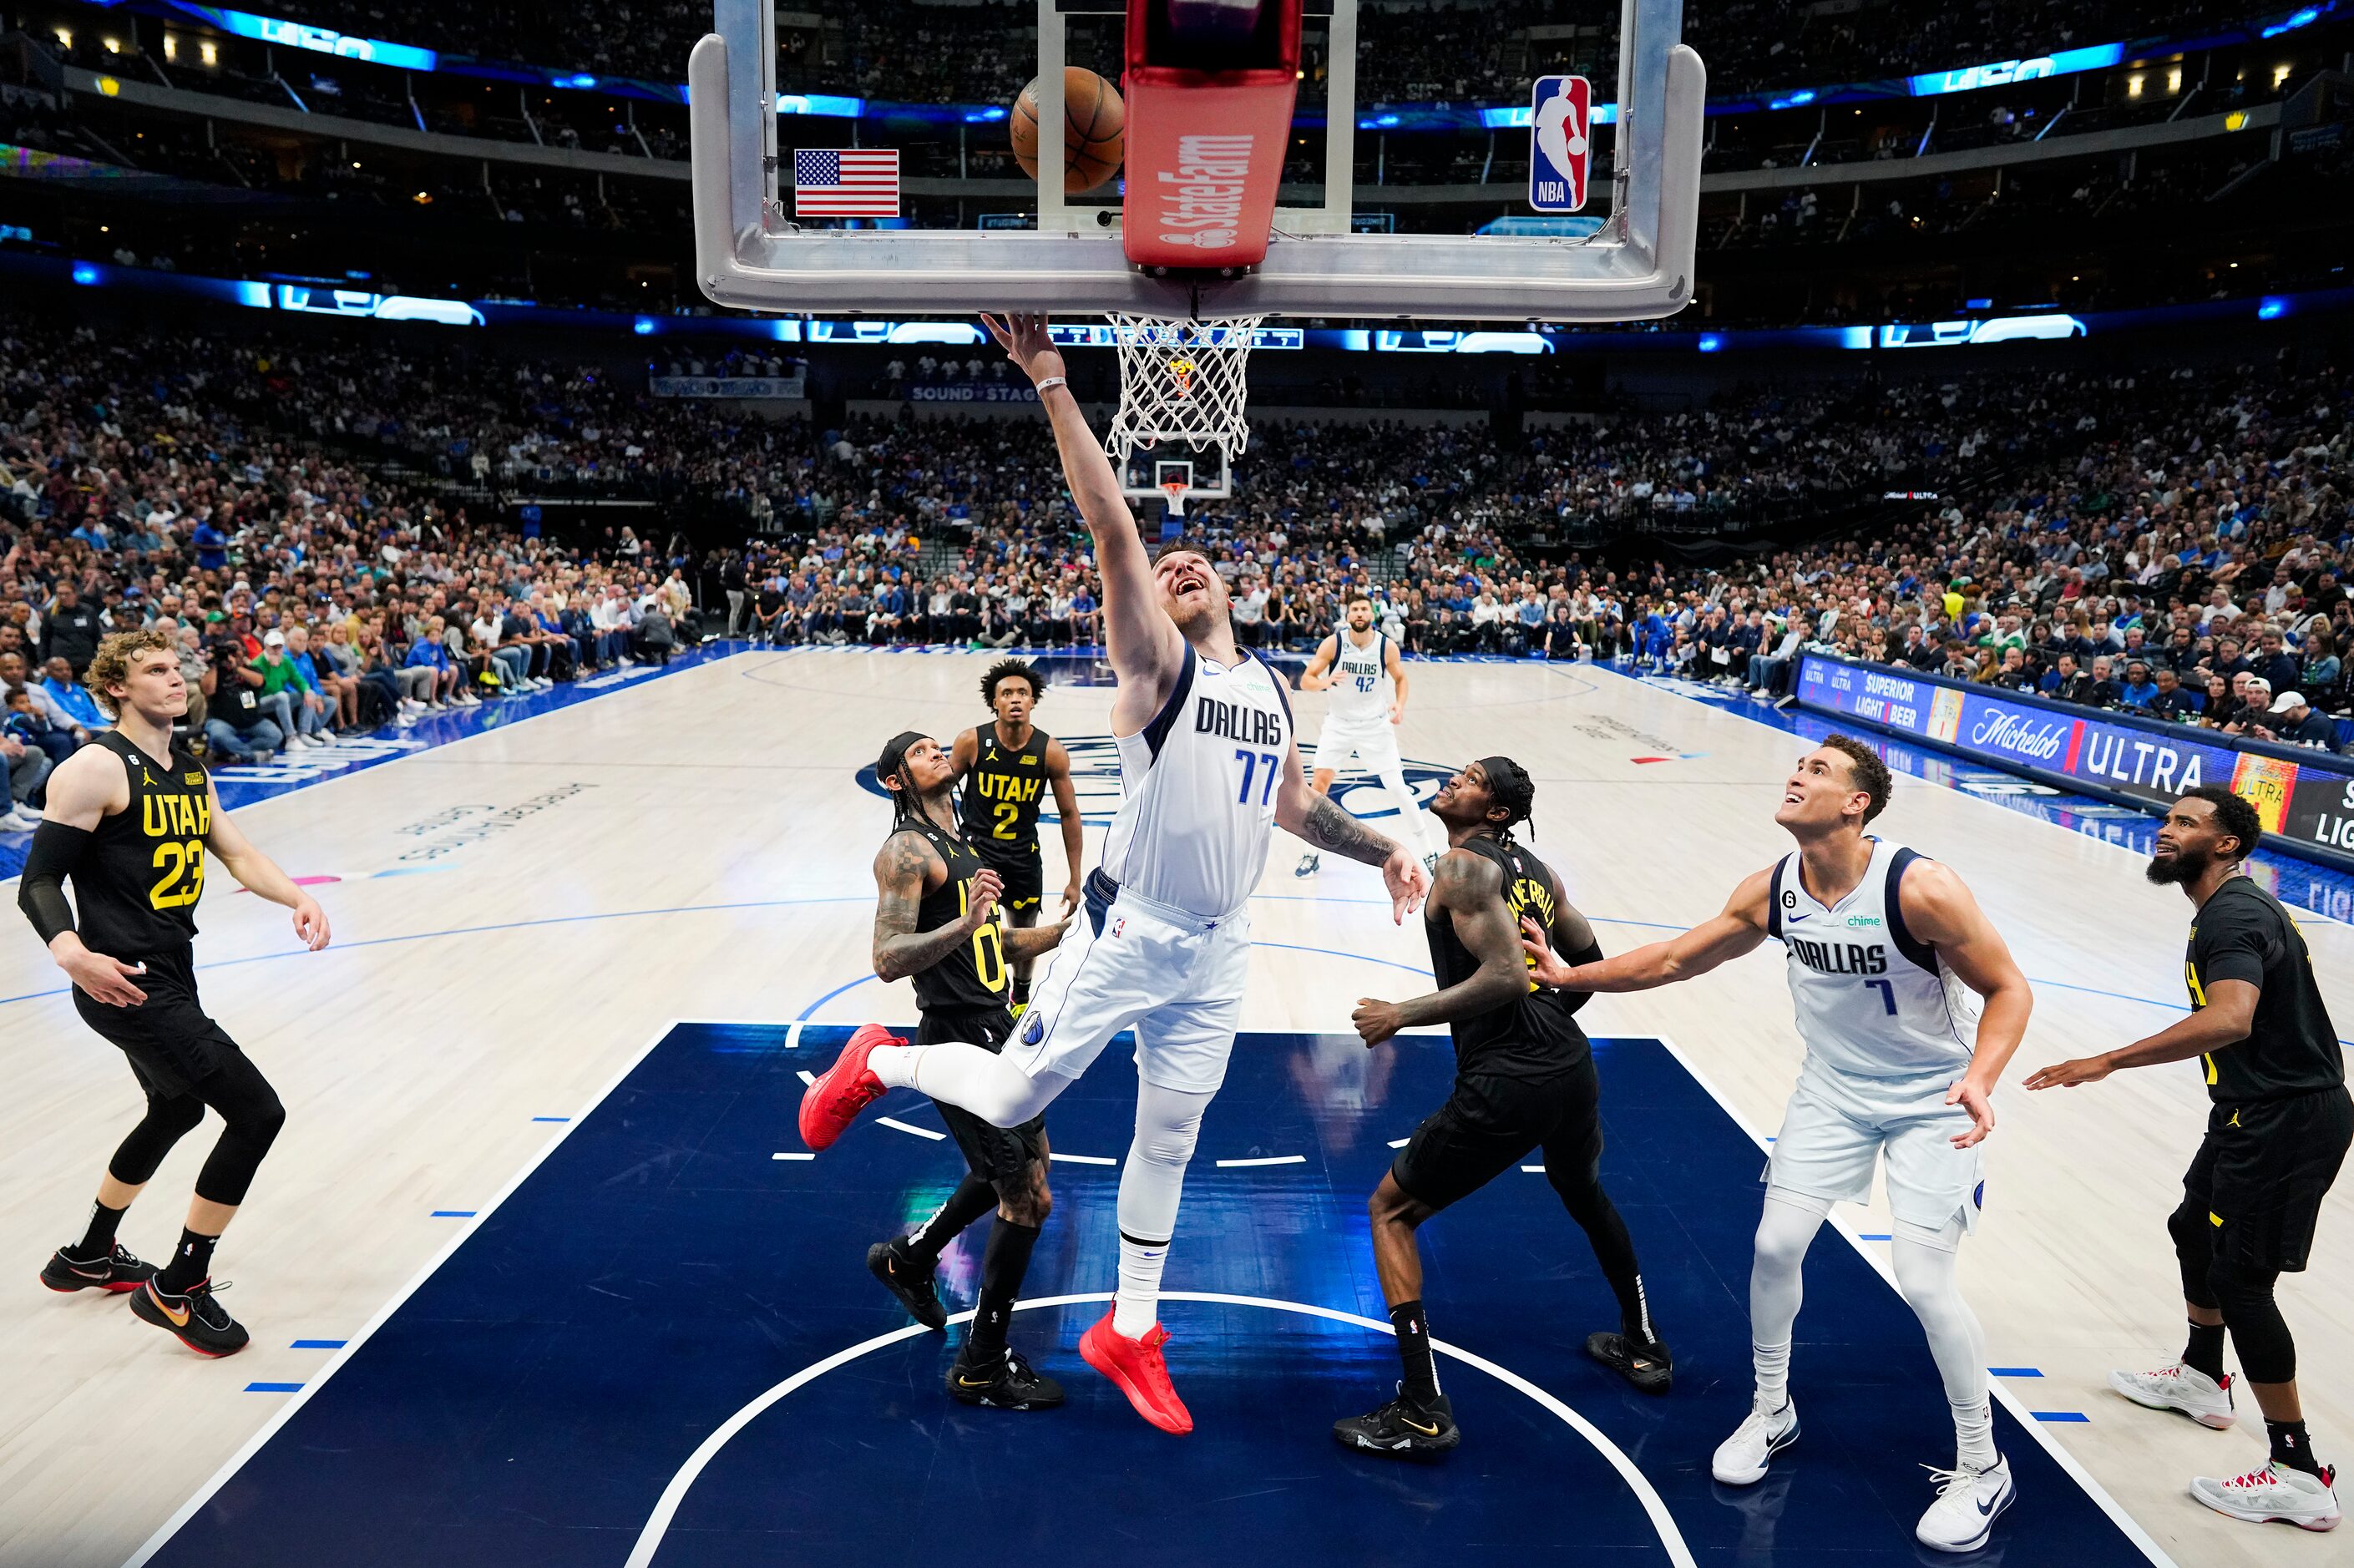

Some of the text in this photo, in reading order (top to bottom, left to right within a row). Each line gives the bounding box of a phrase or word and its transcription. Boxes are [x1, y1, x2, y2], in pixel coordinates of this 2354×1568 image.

[1538, 181, 1565, 202] NBA
[913, 387, 1044, 401] SOUND STAG
[1355, 675, 1375, 693] 42
[1805, 669, 1824, 685] ULTRA
[1830, 675, 1851, 692] ULTRA
[1865, 673, 1915, 703] SUPERIOR
[1194, 695, 1282, 746] DALLAS
[1855, 695, 1917, 729] LIGHT BEER
[1972, 708, 2201, 796] Michelob ULTRA
[978, 771, 1041, 802] UTAH
[1234, 747, 1279, 807] 77
[2236, 777, 2283, 804] ULTRA
[143, 794, 210, 837] UTAH
[992, 802, 1019, 841] 2
[149, 838, 205, 911] 23
[1785, 893, 1795, 907] 6
[1847, 915, 1881, 926] chime
[1793, 938, 1887, 976] DALLAS
[1863, 979, 1899, 1016] 7
